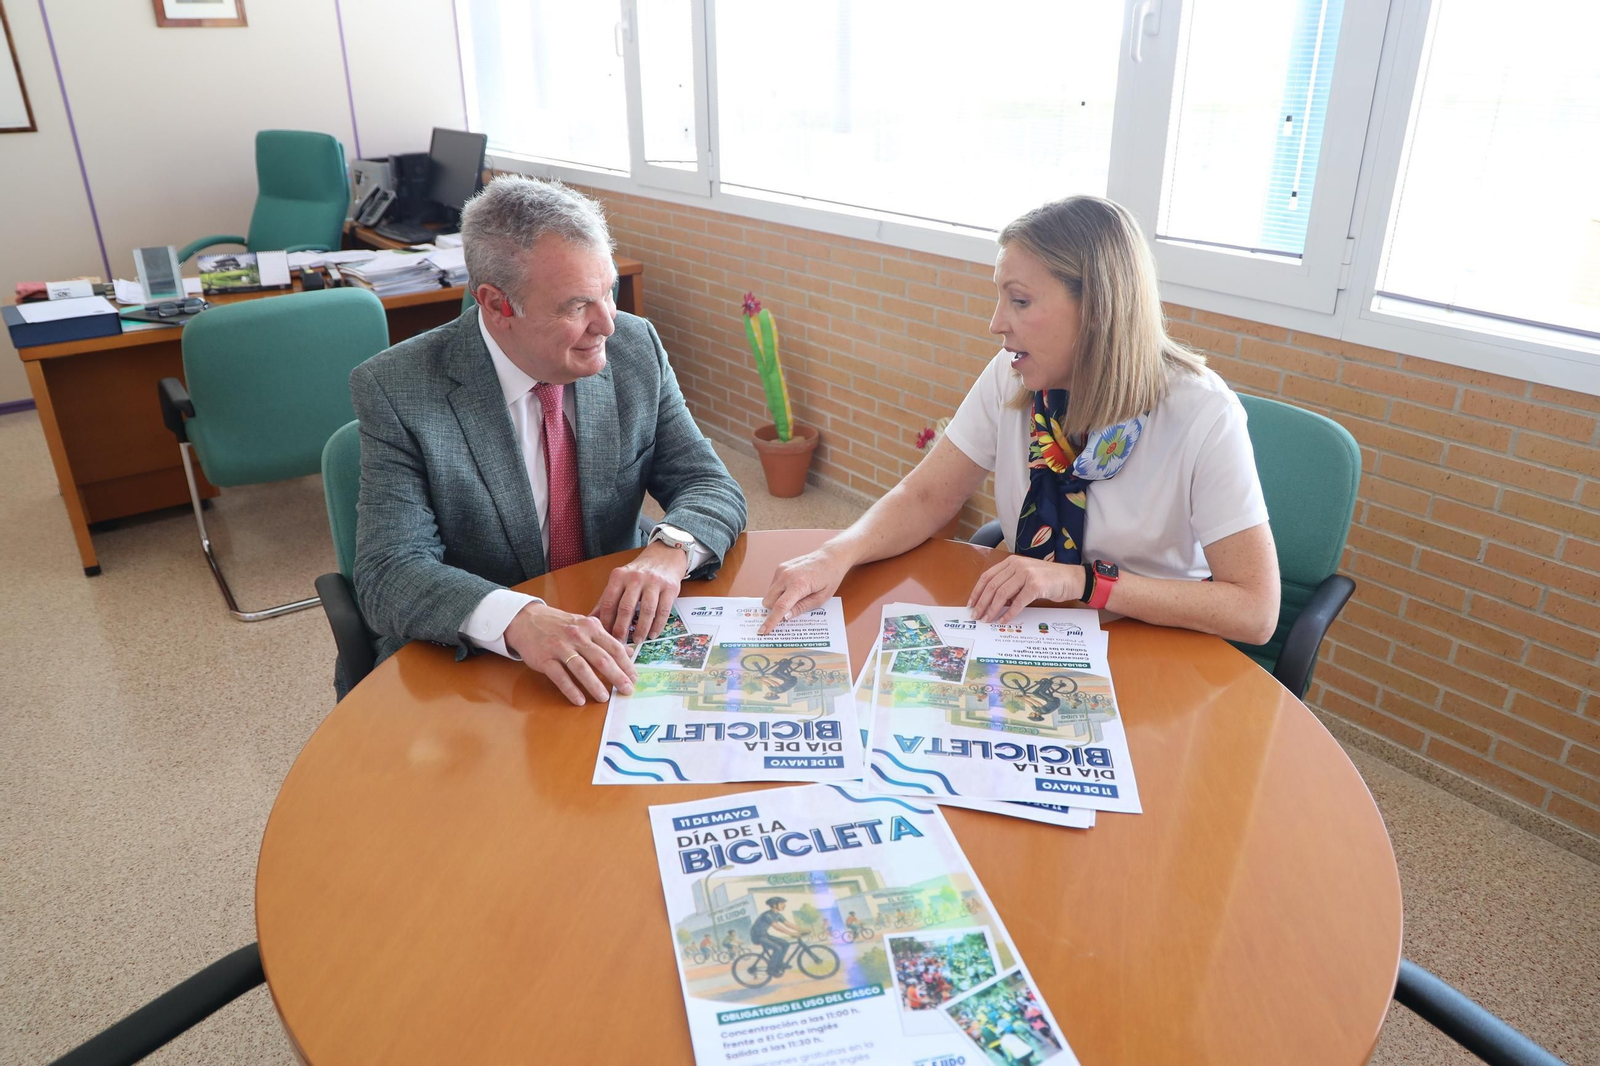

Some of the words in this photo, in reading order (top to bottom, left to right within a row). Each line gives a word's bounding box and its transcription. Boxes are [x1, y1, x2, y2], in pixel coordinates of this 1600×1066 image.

[629, 720, 842, 744] BICICLETA
[744, 742, 768, 751] LA
[775, 742, 800, 752] DE
[806, 742, 842, 755] DÍA
[893, 735, 1114, 768] BICICLETA
[1013, 763, 1039, 773] LA
[1045, 765, 1071, 776] DE
[1077, 768, 1115, 782] DÍA
[1042, 782, 1081, 792] MAYO
[1084, 786, 1099, 794] DE
[1101, 787, 1112, 795] 11
[679, 819, 690, 827] 11
[693, 816, 709, 826] DE
[711, 810, 751, 823] MAYO
[677, 830, 718, 848] DÍA
[723, 825, 753, 839] DE
[758, 820, 787, 834] LA
[678, 815, 924, 874] BICICLETA
[721, 1004, 790, 1022] OBLIGATORIO
[791, 1002, 802, 1011] EL
[803, 999, 825, 1008] USO
[826, 995, 843, 1005] DEL
[844, 987, 880, 1000] CASCO
[721, 1020, 799, 1039] Concentración
[723, 1039, 755, 1050] frente
[777, 1029, 805, 1039] Corte
[807, 1023, 838, 1034] Inglés
[725, 1049, 759, 1060] Salida
